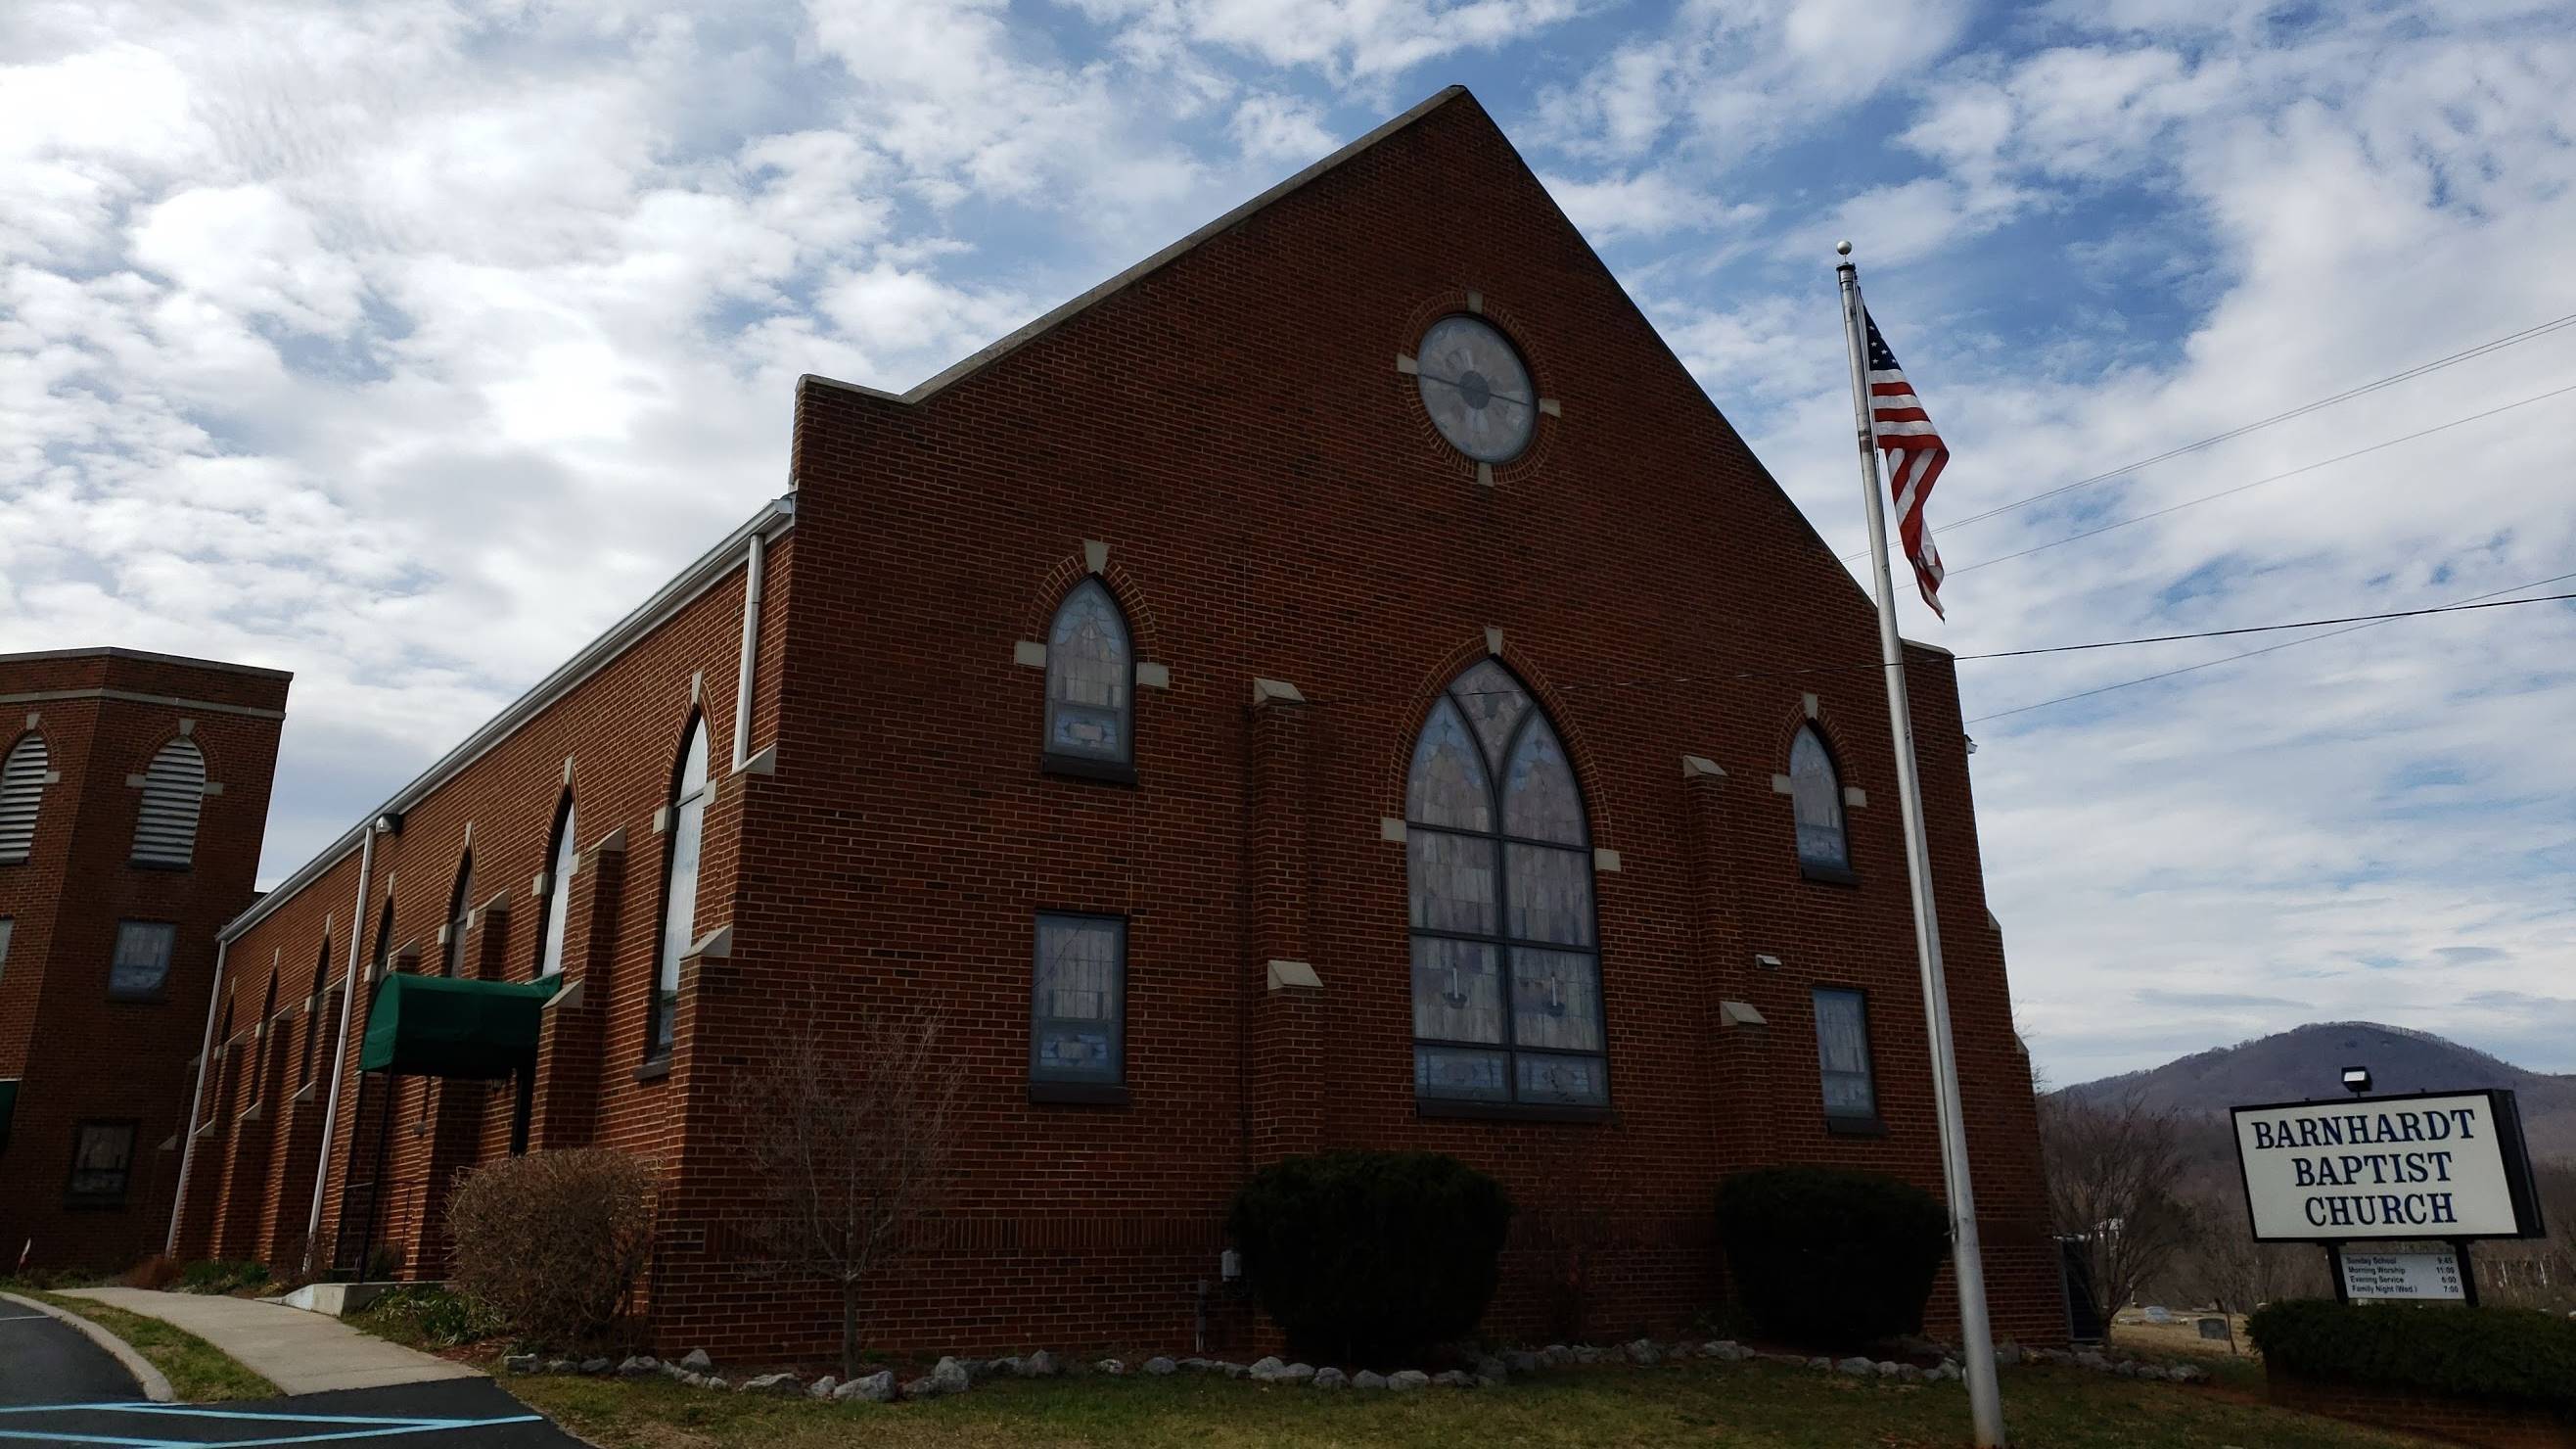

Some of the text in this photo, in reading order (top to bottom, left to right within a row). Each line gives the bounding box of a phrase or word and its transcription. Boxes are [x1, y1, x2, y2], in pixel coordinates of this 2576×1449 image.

[2251, 1108, 2475, 1149] BARNHARDT
[2292, 1151, 2453, 1187] BAPTIST
[2305, 1192, 2458, 1227] CHURCH
[2352, 1285, 2374, 1293] Family
[2375, 1285, 2394, 1293] Night
